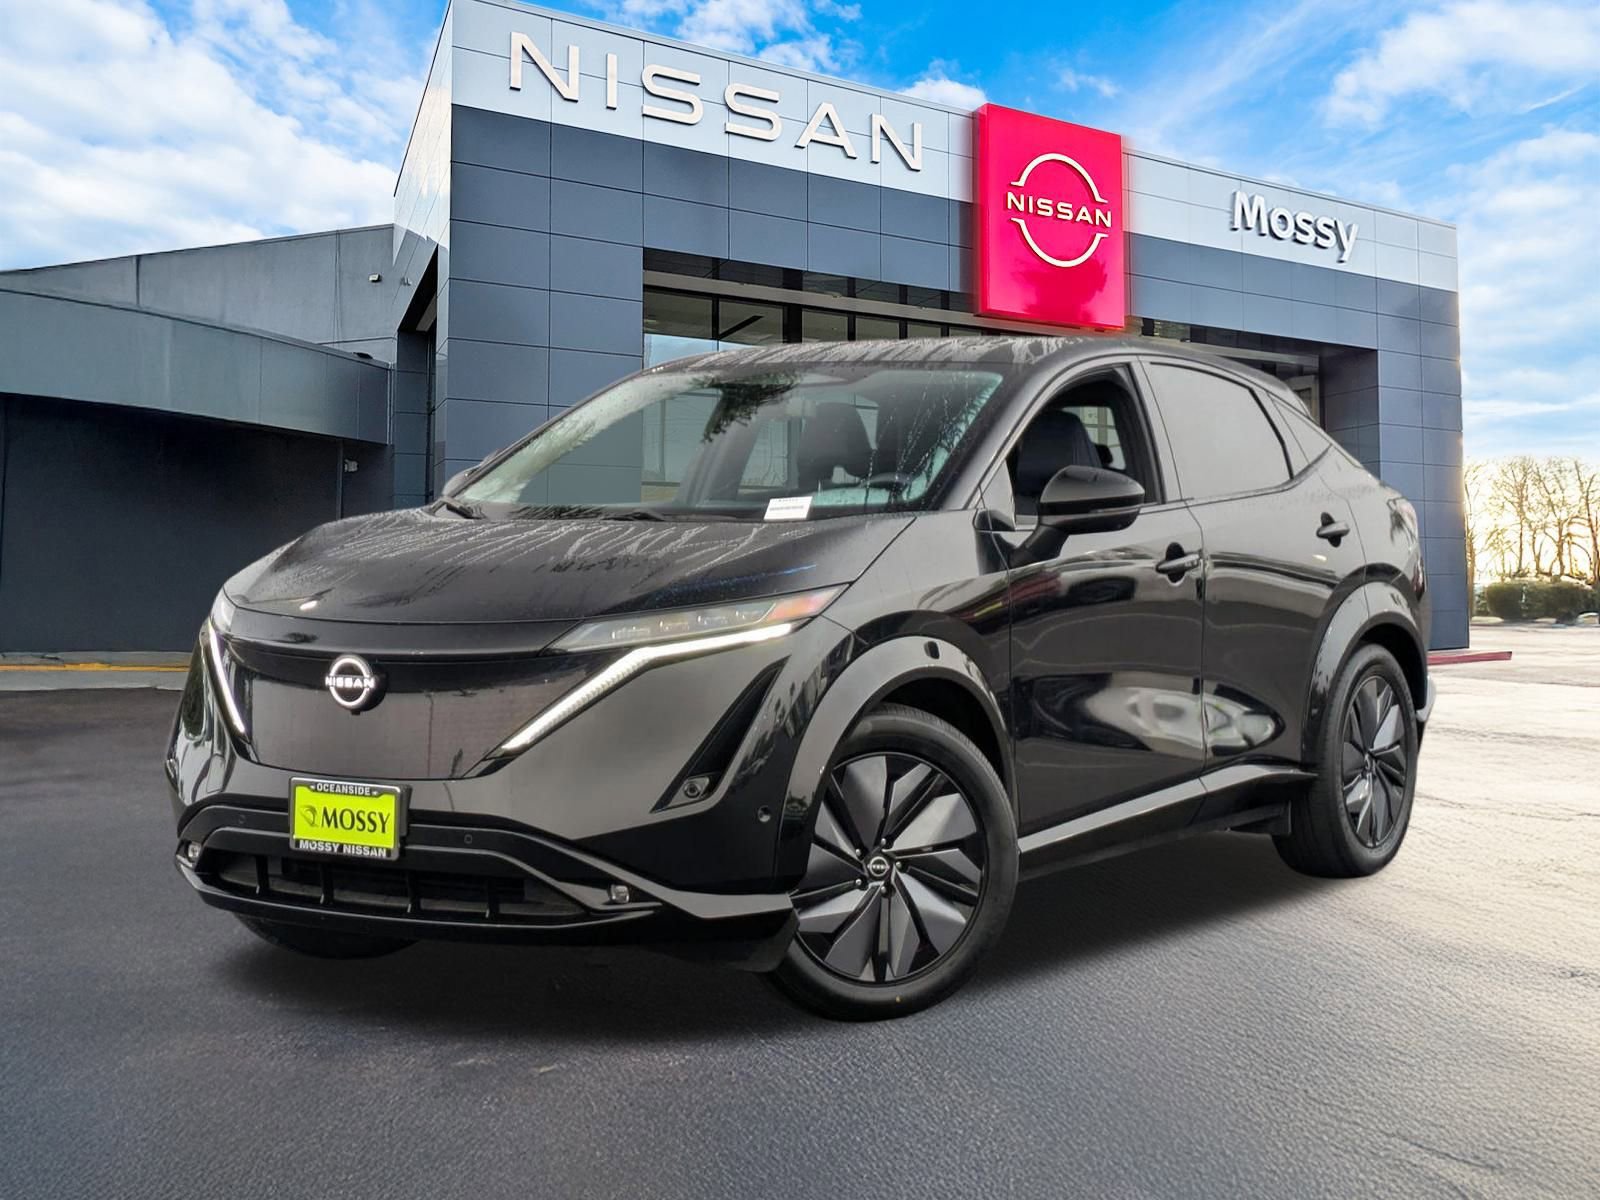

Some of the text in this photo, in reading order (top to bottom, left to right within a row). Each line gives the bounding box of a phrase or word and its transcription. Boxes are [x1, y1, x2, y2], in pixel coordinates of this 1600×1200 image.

[509, 31, 922, 172] NISSAN
[1007, 191, 1112, 228] NISSAN
[1231, 190, 1359, 263] Mossy
[325, 676, 375, 689] NISSAN
[316, 783, 371, 796] OCEANSIDE
[321, 806, 391, 834] MOSSY
[299, 839, 387, 858] MOSSY NISSAN
